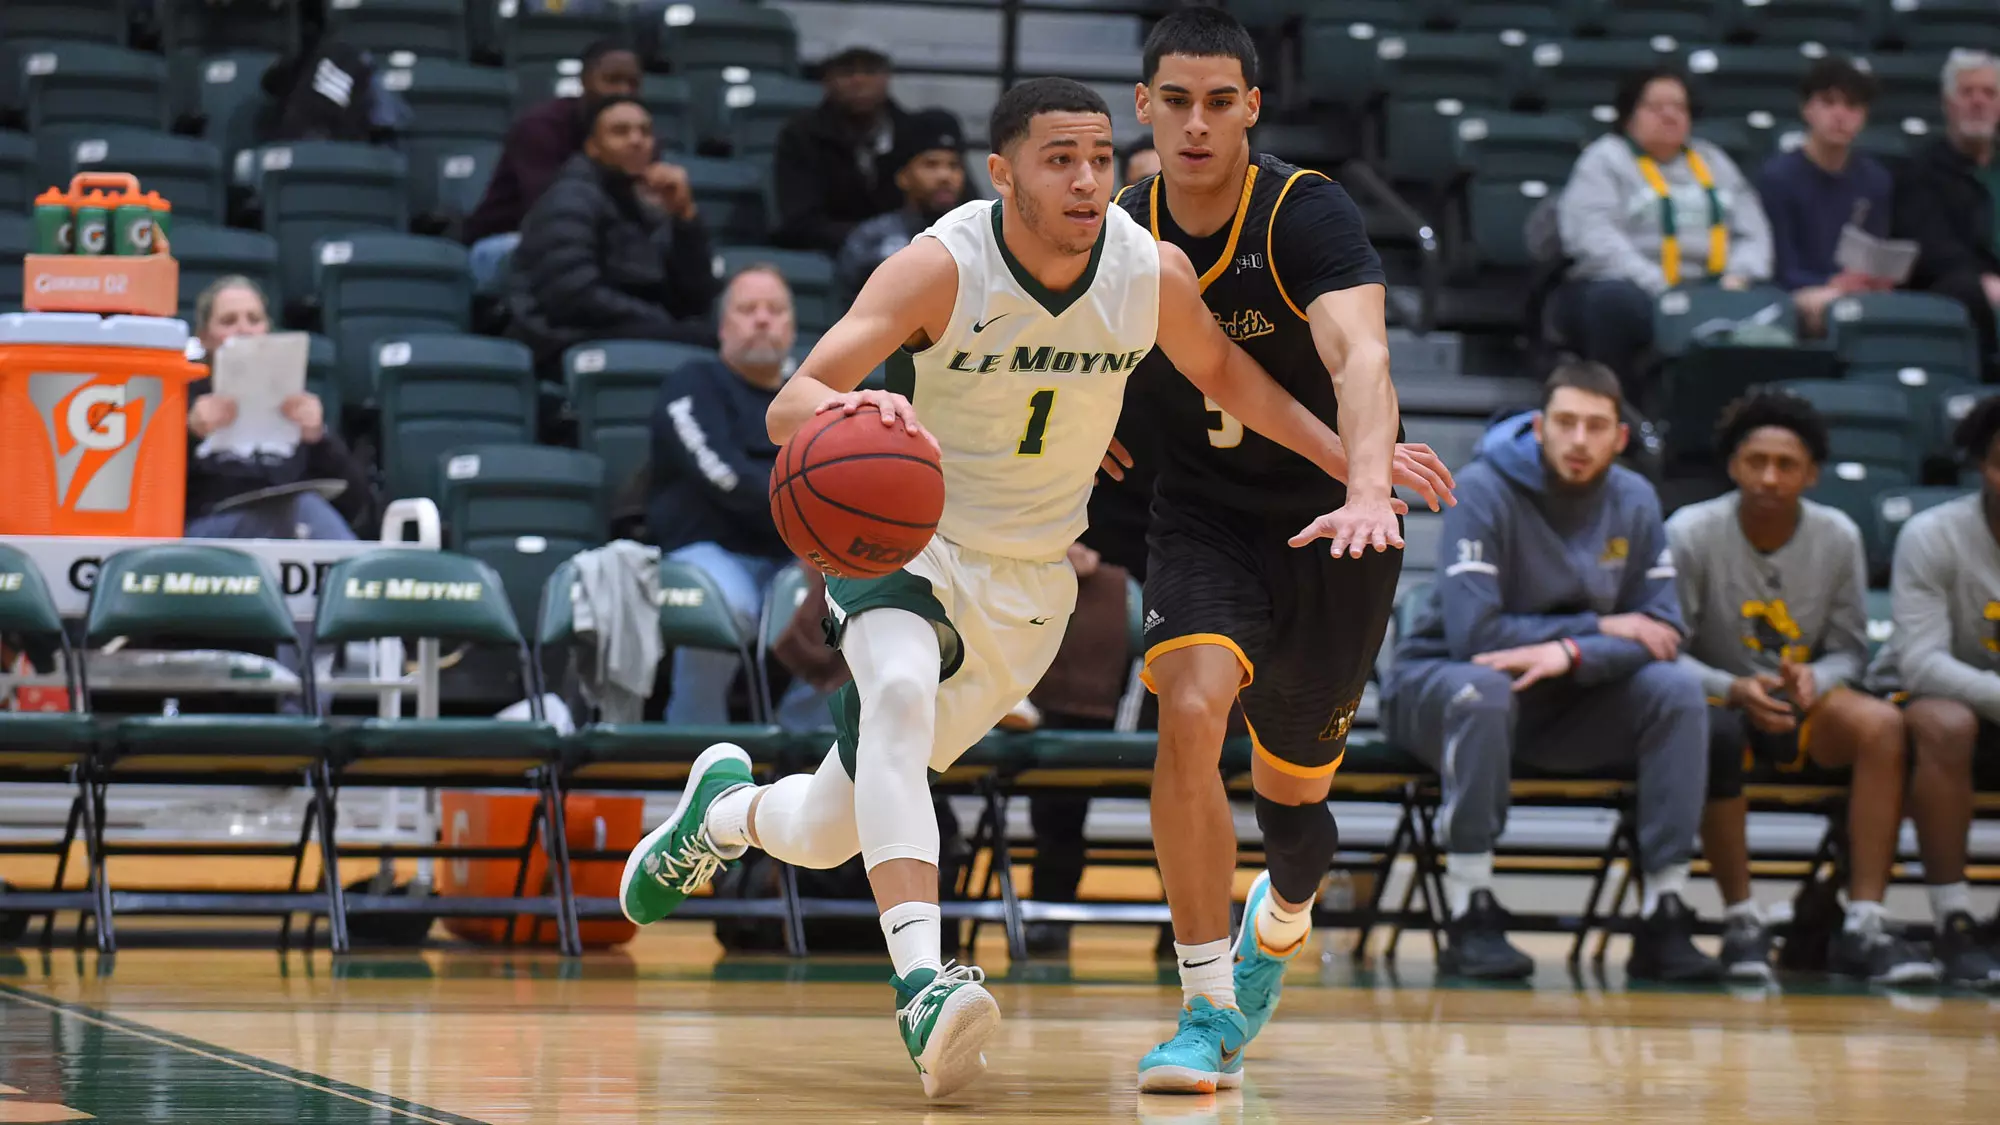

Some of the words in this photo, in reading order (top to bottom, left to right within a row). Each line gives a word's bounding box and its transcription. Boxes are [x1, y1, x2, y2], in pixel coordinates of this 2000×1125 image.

[81, 222, 106, 252] G
[947, 350, 1004, 374] LE
[1009, 346, 1145, 374] MOYNE
[67, 384, 126, 450] G
[1014, 387, 1058, 458] 1
[122, 571, 160, 592] LE
[163, 571, 260, 594] MOYNE
[345, 577, 382, 599] LE
[386, 578, 482, 601] MOYNE
